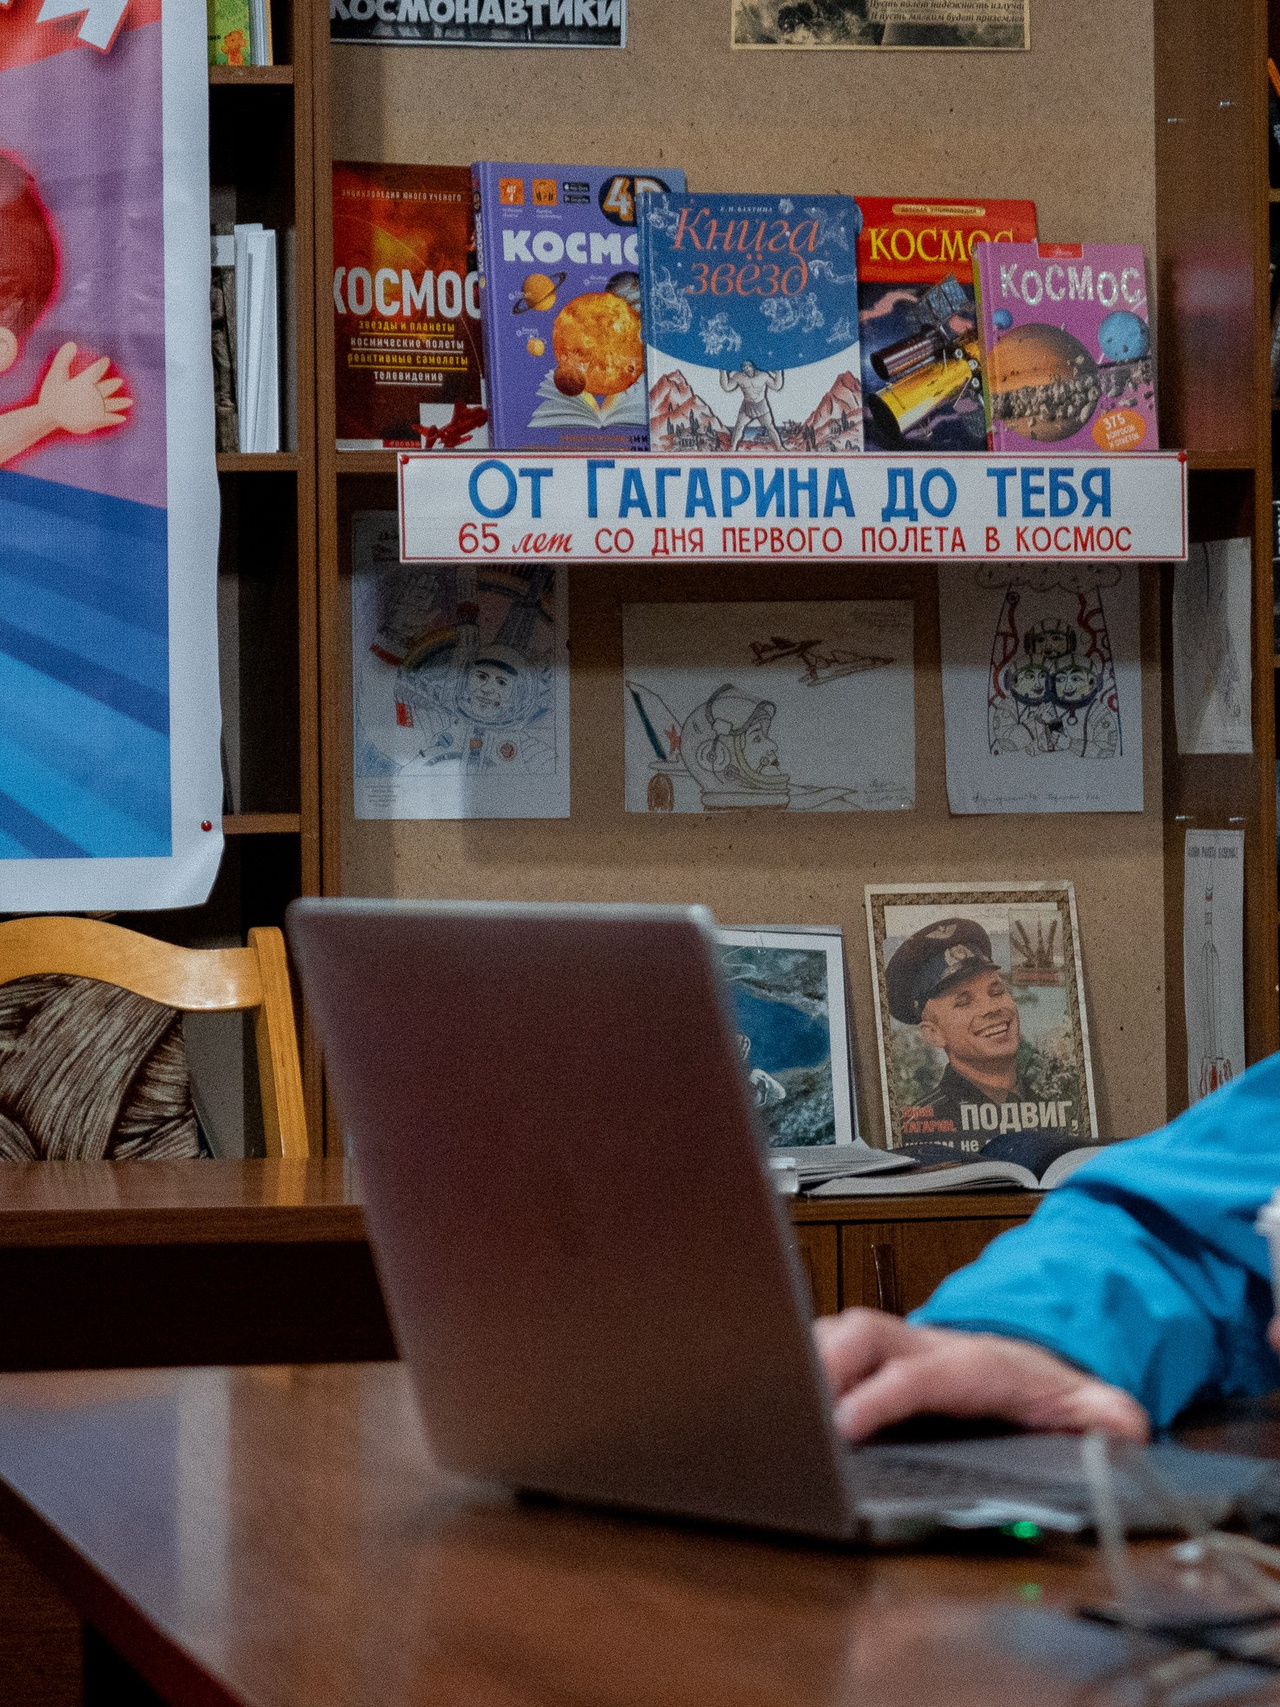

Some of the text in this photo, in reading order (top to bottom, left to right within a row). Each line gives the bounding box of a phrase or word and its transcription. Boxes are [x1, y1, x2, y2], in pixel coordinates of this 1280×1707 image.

[331, 0, 621, 26] КОСМОНАВТИКИ
[670, 207, 820, 252] Книга
[1000, 264, 1142, 307] КОСМОС
[374, 371, 444, 382] телевидение
[881, 466, 958, 522] ДО
[986, 466, 1111, 518] ТЕБЯ
[458, 522, 1132, 556] 65 лет СО ДНЯ ПЕРВОГО ПОЛЕТА В КОСМОС
[960, 1101, 1079, 1136] ПОДВИГ,
